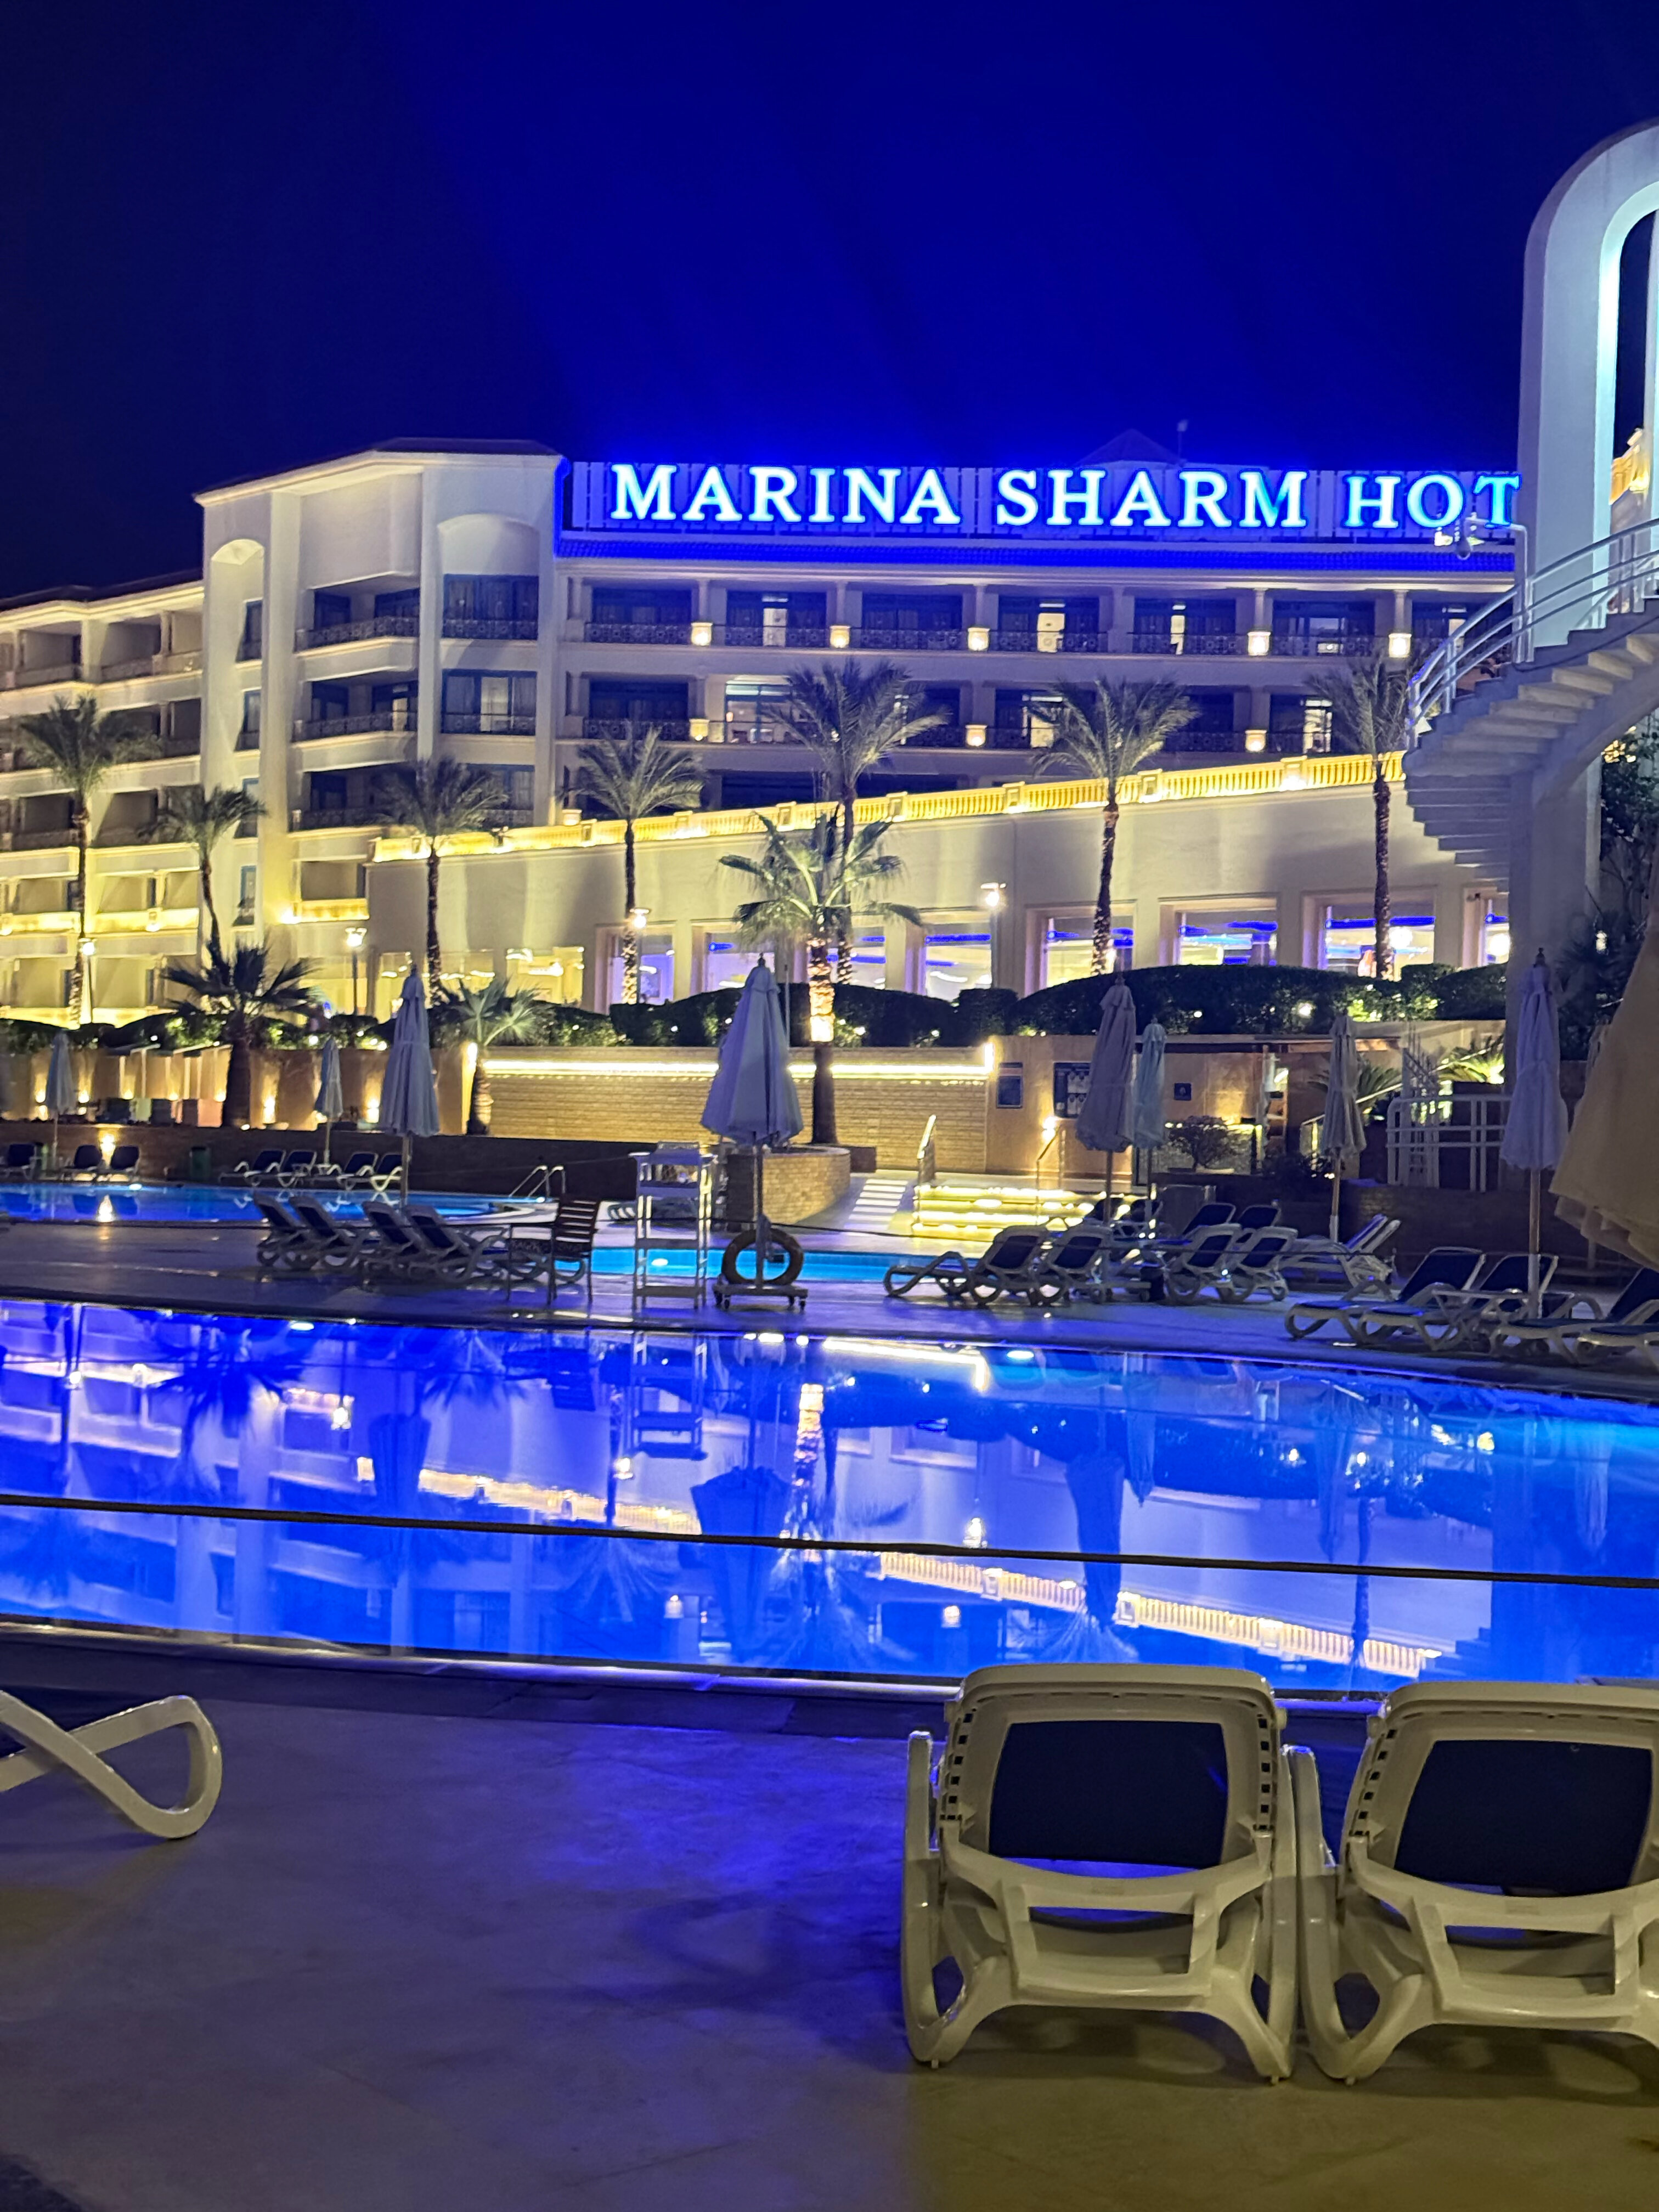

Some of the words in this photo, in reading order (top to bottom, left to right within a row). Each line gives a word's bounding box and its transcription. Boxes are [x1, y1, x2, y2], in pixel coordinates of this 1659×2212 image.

[611, 464, 961, 524] MARINA
[996, 470, 1307, 527] SHARM
[1343, 474, 1520, 528] HOT
